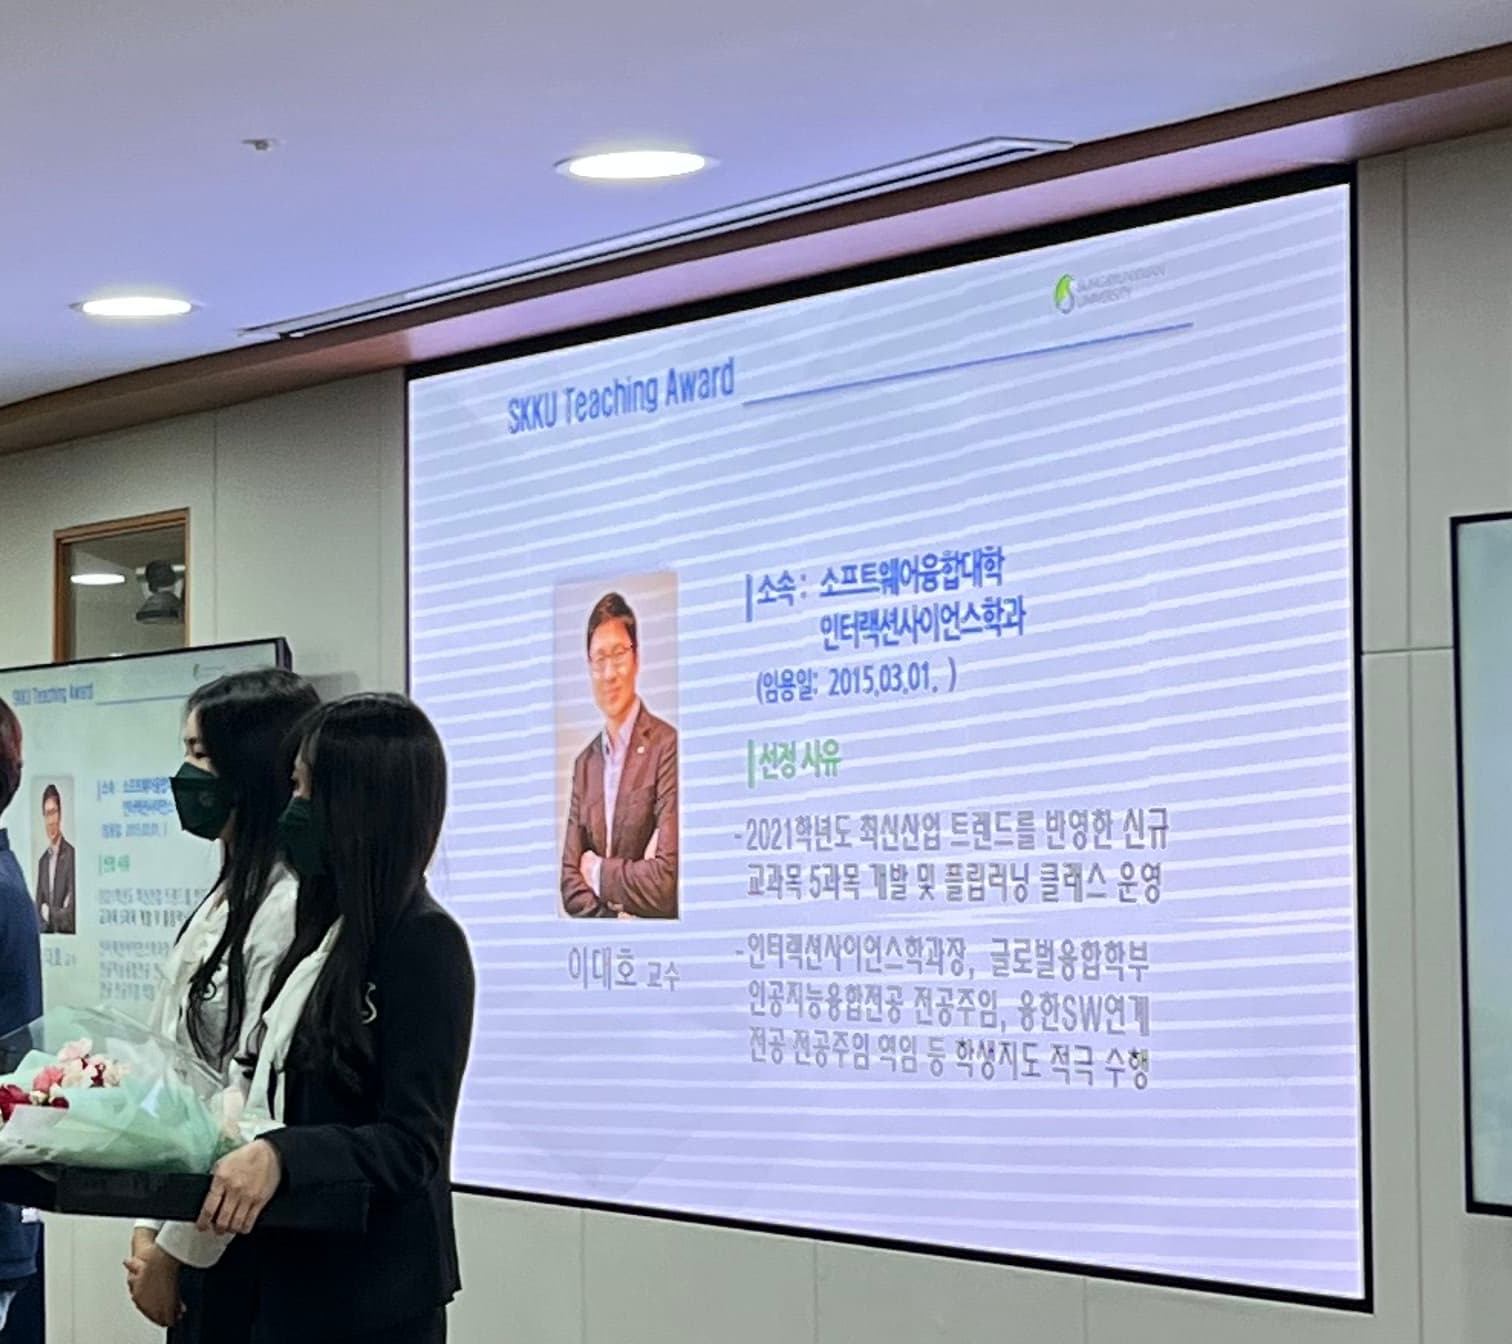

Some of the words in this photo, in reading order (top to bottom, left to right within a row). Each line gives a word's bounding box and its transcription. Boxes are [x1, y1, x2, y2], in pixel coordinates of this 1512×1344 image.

[507, 391, 558, 434] SKKU
[563, 376, 658, 426] Teaching
[665, 356, 735, 406] Award
[819, 546, 1006, 597] 소프트웨어융합대학
[820, 595, 1027, 651] 인터랙션사이언스학과
[759, 741, 796, 780] 선정
[801, 738, 842, 777] 사유
[859, 812, 941, 851] 최신산업
[951, 810, 1036, 850] 트렌드를
[1046, 809, 1113, 850] 반영한
[1123, 808, 1169, 849] 신규
[747, 863, 801, 900] 교과목
[809, 863, 860, 900] 5과목
[869, 863, 908, 900] 개발
[917, 863, 935, 900] 및
[945, 862, 1029, 903] 플립러닝
[1040, 862, 1107, 903] 클래스
[1117, 861, 1161, 904] 운영
[569, 946, 637, 991] 이대호
[647, 961, 681, 992] 교수
[990, 937, 1149, 982] 글로벌융합학부
[749, 979, 903, 1025] 인공지능융합전공
[749, 1026, 785, 1064] 전공
[793, 1029, 869, 1070] 전공주임
[878, 1033, 917, 1073] 역임
[927, 1036, 946, 1077] 등
[956, 1037, 1041, 1081] 학생지도
[1050, 1043, 1093, 1086] 적극
[1105, 1048, 1149, 1090] 수행
